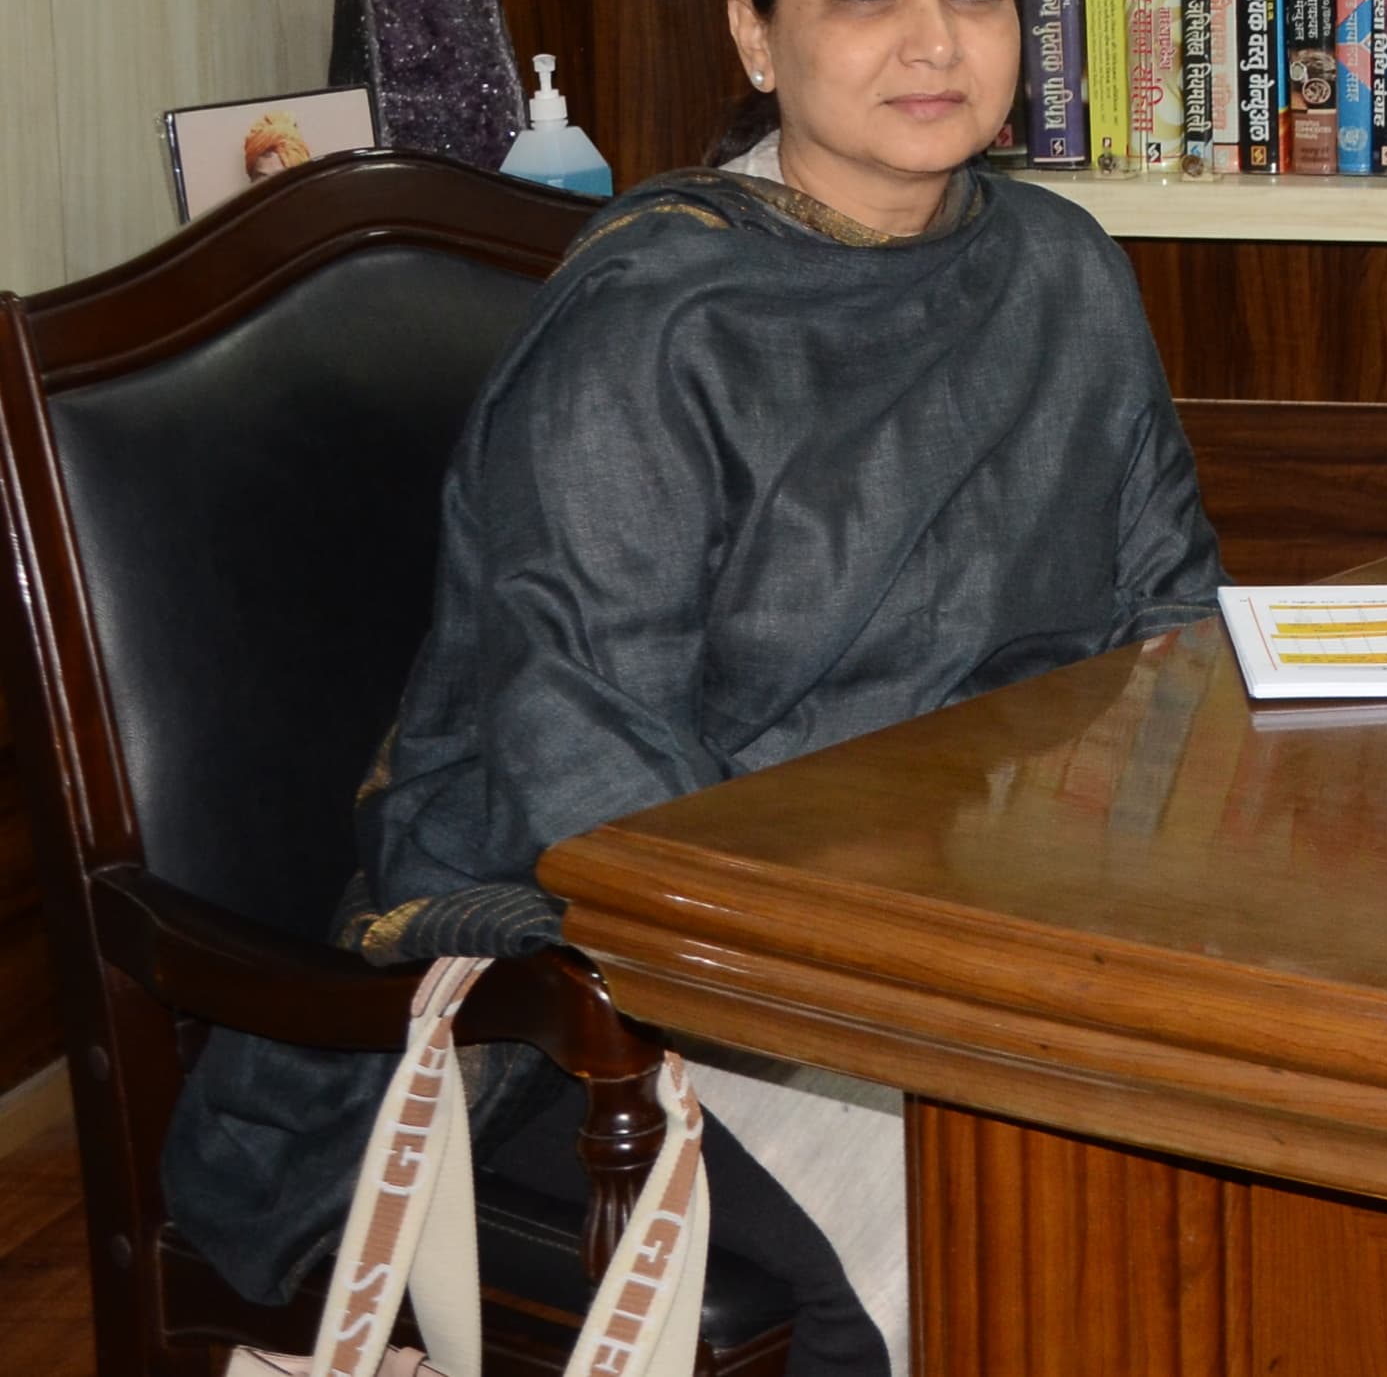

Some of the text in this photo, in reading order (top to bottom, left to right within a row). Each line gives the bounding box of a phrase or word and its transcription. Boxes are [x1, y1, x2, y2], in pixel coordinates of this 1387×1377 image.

[1032, 21, 1063, 72] पुस्तक
[1238, 33, 1267, 71] वस्तु
[1373, 33, 1387, 73] विधि
[1042, 76, 1074, 130] परिपत्र
[1130, 62, 1164, 133] संहिता
[1185, 62, 1211, 133] नियमावली
[1240, 73, 1275, 141] मेन्युअल
[1373, 78, 1387, 126] संग्रह
